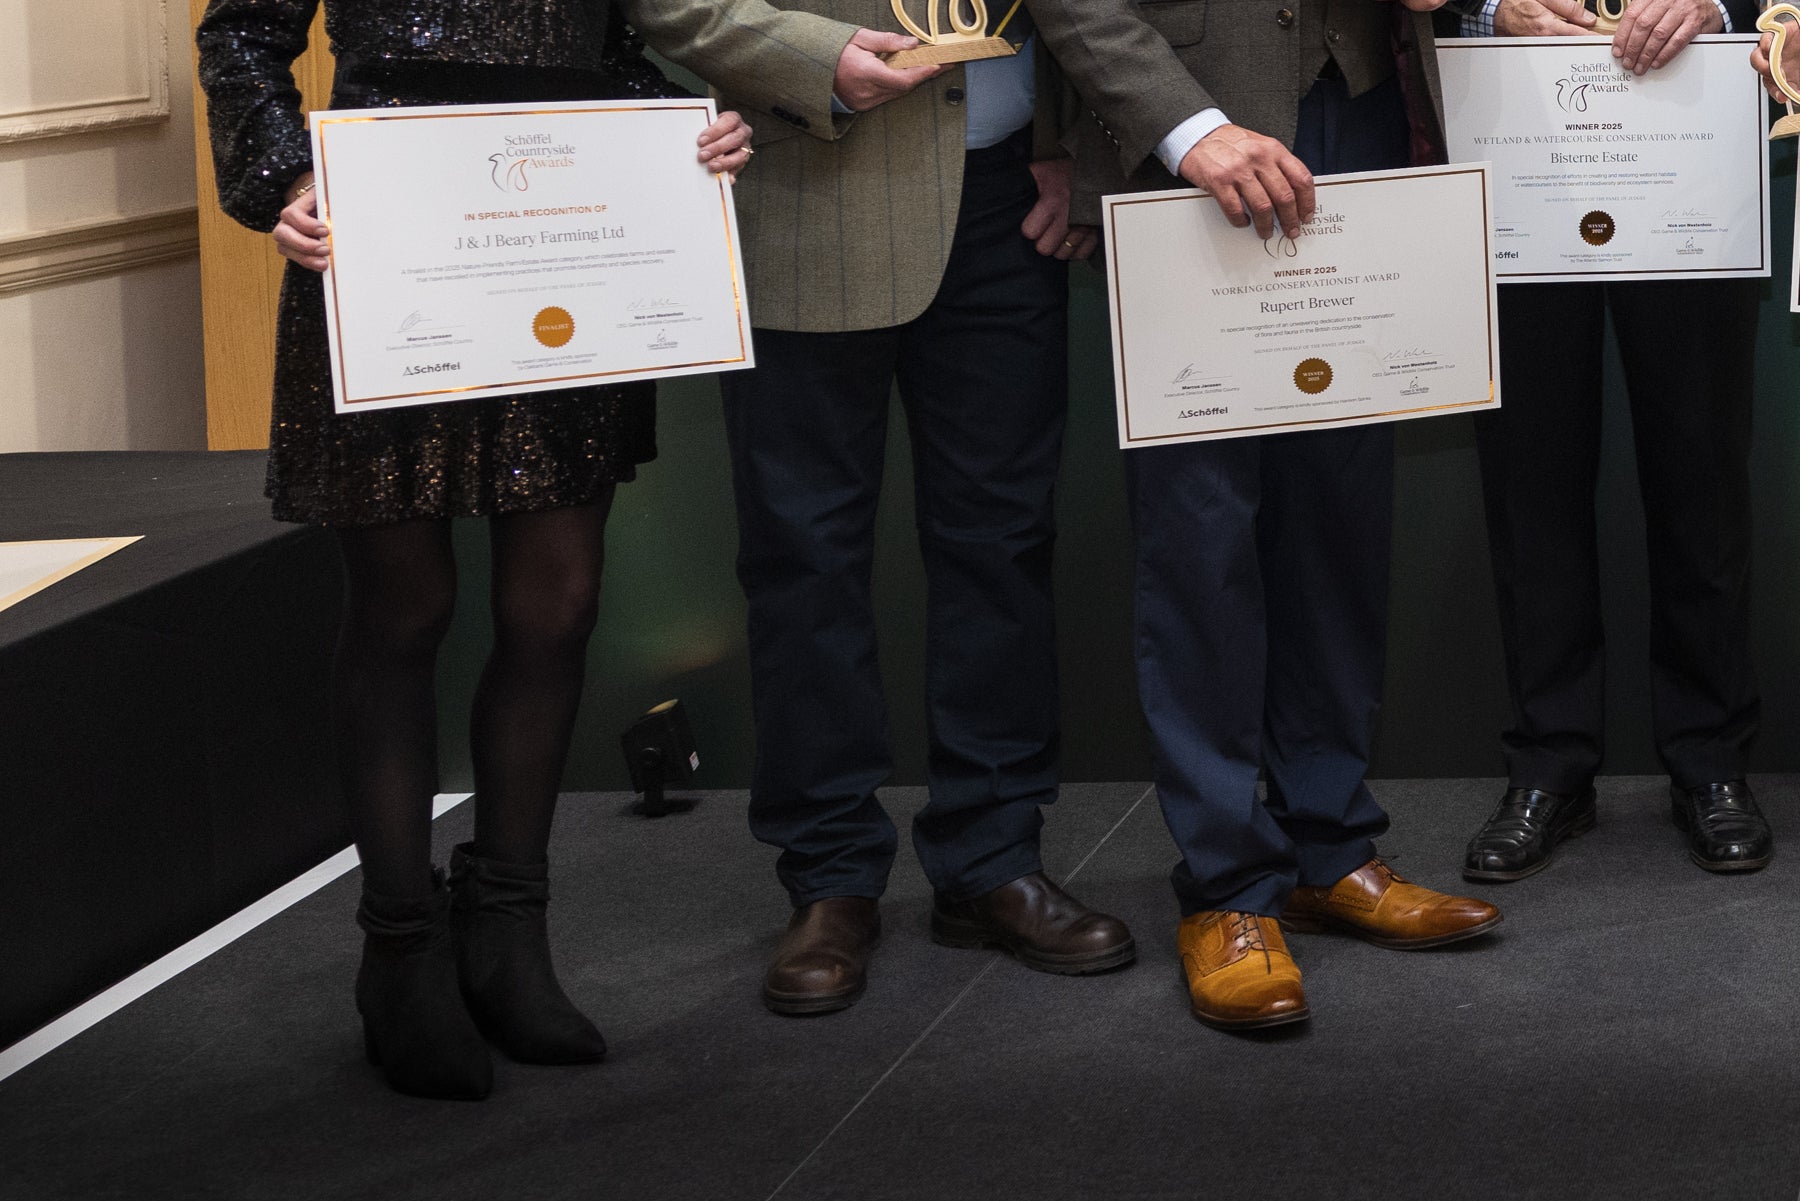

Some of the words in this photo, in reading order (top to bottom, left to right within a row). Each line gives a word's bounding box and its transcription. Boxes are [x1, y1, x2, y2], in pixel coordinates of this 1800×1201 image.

[1570, 62, 1611, 73] Schöffel
[1570, 71, 1633, 84] Countryside
[1588, 82, 1629, 93] Awards
[1565, 123, 1600, 131] WINNER
[1601, 122, 1623, 130] 2025
[503, 133, 552, 146] Schöffel
[1473, 136, 1523, 145] WETLAND
[1523, 136, 1532, 144] &
[1533, 134, 1604, 144] WATERCOURSE
[1605, 133, 1677, 143] CONSERVATION
[1679, 132, 1714, 141] AWARD
[505, 143, 576, 158] Countryside
[527, 155, 575, 169] Awards
[1550, 152, 1599, 164] Bisterne
[1602, 151, 1639, 163] Estate
[464, 213, 476, 222] IN
[477, 210, 522, 221] SPECIAL
[522, 205, 592, 217] RECOGNITION
[593, 204, 608, 213] OF
[454, 236, 463, 250] J
[466, 235, 480, 250] &
[482, 234, 491, 249] J
[495, 233, 537, 248] Beary
[540, 228, 600, 244] Farming
[601, 225, 625, 240] Ltd
[1273, 268, 1312, 278] WINNER
[1313, 265, 1337, 275] 2025
[1211, 284, 1263, 296] WORKING
[1264, 275, 1360, 292] CONSERVATIONIST
[1362, 272, 1400, 283] AWARD
[1260, 300, 1305, 315] Rupert
[1308, 296, 1356, 309] Brewer
[538, 323, 570, 332] FINALIST
[413, 361, 461, 375] Schöffel
[1187, 406, 1229, 418] Schöffel
